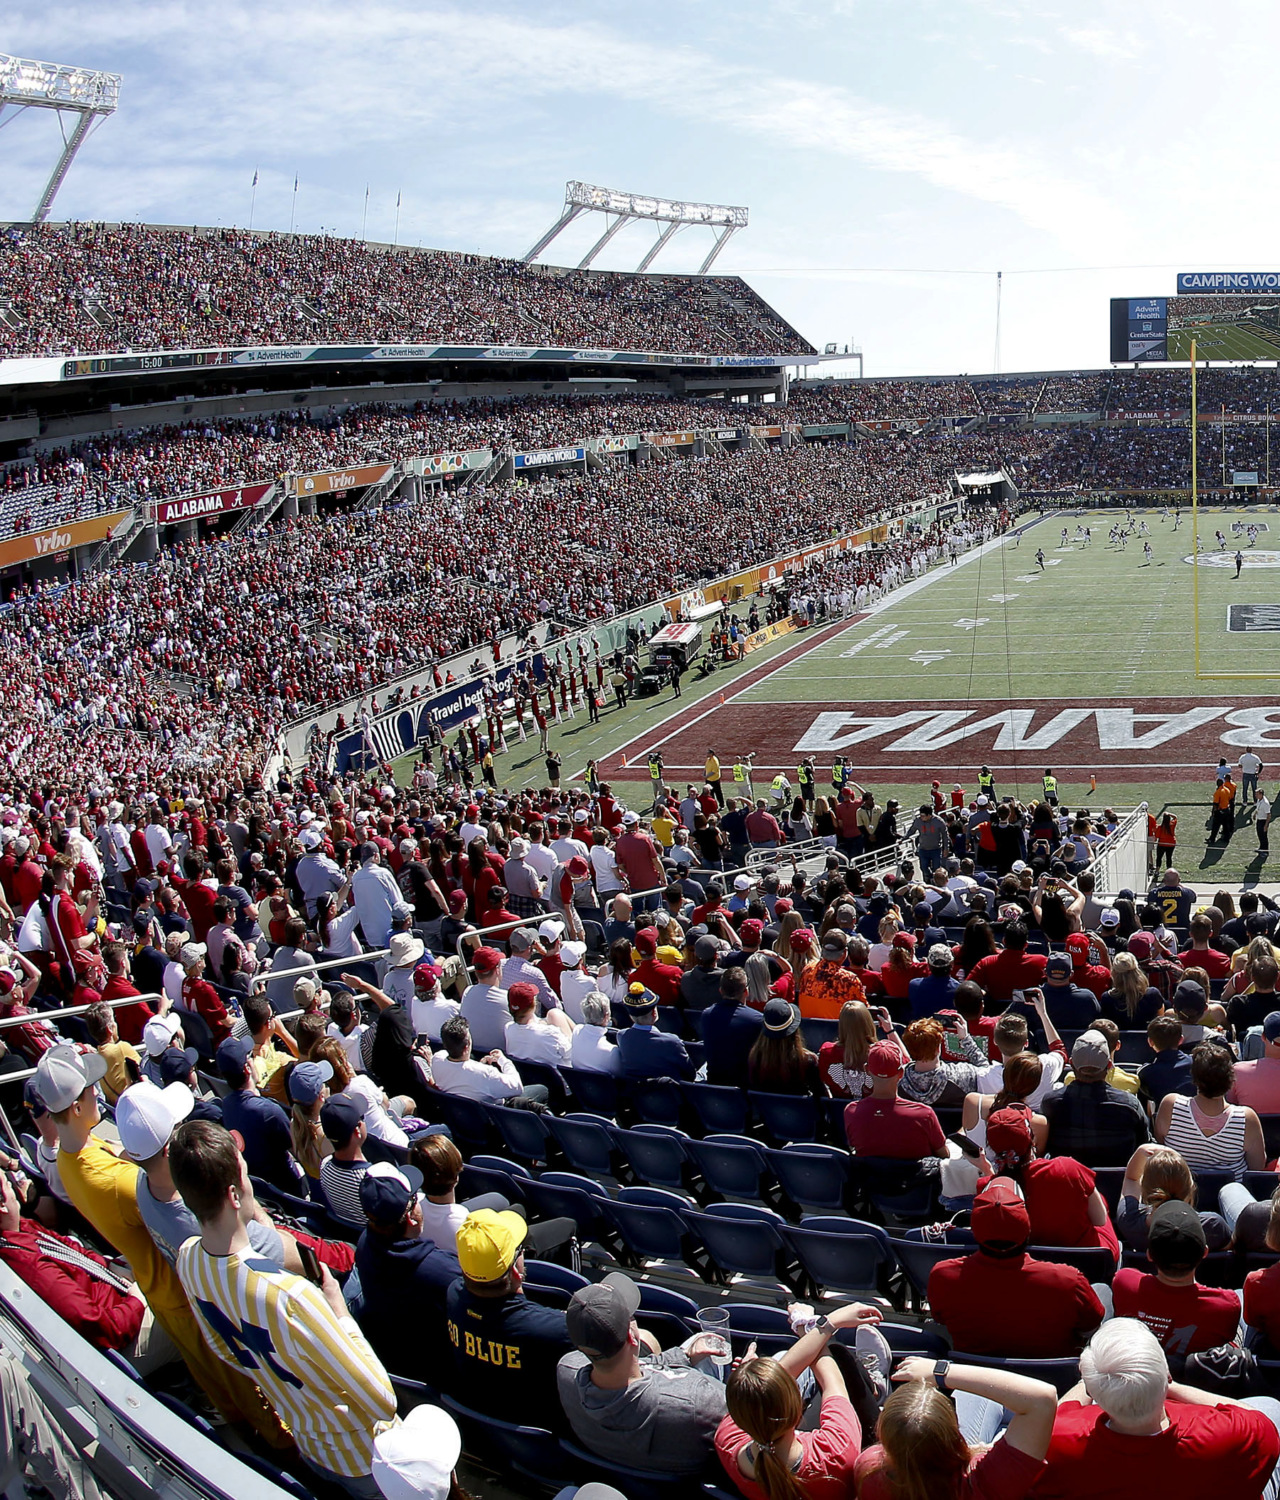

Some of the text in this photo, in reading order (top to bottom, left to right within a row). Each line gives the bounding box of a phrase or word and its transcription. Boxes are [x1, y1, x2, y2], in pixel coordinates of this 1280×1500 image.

[1182, 274, 1249, 288] CAMPING
[256, 350, 302, 361] AdventHealth
[386, 348, 426, 357] AdventHealth
[100, 360, 106, 372] 0
[140, 356, 163, 369] 15:00
[196, 354, 203, 365] 0
[725, 356, 776, 366] AdventHealth
[524, 449, 578, 466] CAMPING WORLD
[328, 473, 356, 489] Vrbo
[165, 494, 224, 521] ALABAMA
[34, 530, 72, 555] Vrbo
[431, 695, 463, 722] Travel
[1157, 890, 1182, 898] WOODSON
[1162, 898, 1178, 924] 2
[1068, 945, 1082, 953] USA
[447, 1319, 522, 1369] GO BLUE
